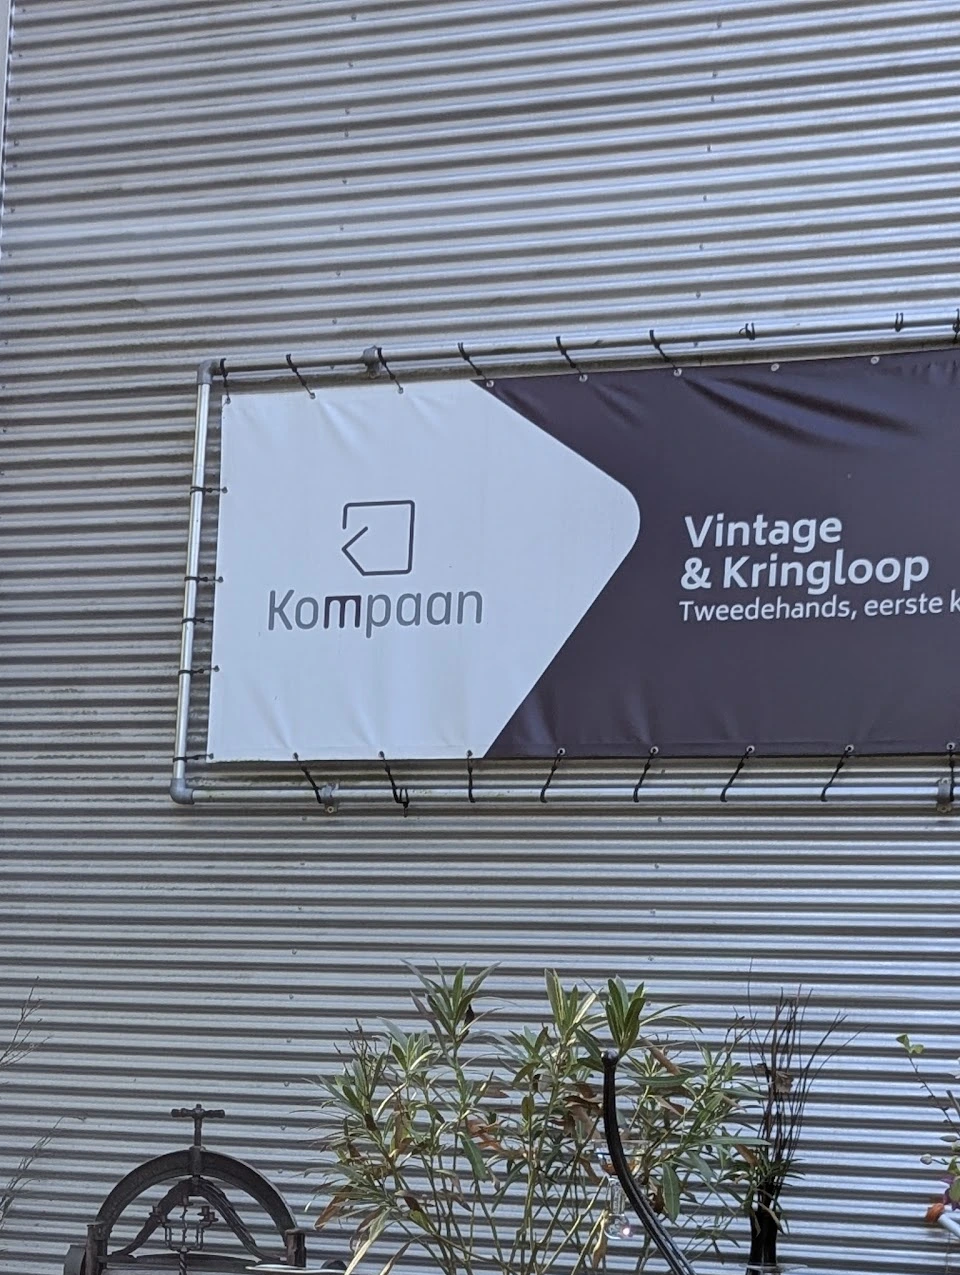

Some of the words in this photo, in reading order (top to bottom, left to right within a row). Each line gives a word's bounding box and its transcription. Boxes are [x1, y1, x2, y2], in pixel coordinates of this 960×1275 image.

[684, 512, 843, 554] Vintage
[680, 556, 712, 590] &
[723, 548, 930, 595] Kringloop
[268, 589, 483, 639] Kompaan
[678, 594, 858, 622] Tweedehands,
[863, 593, 943, 617] eerste
